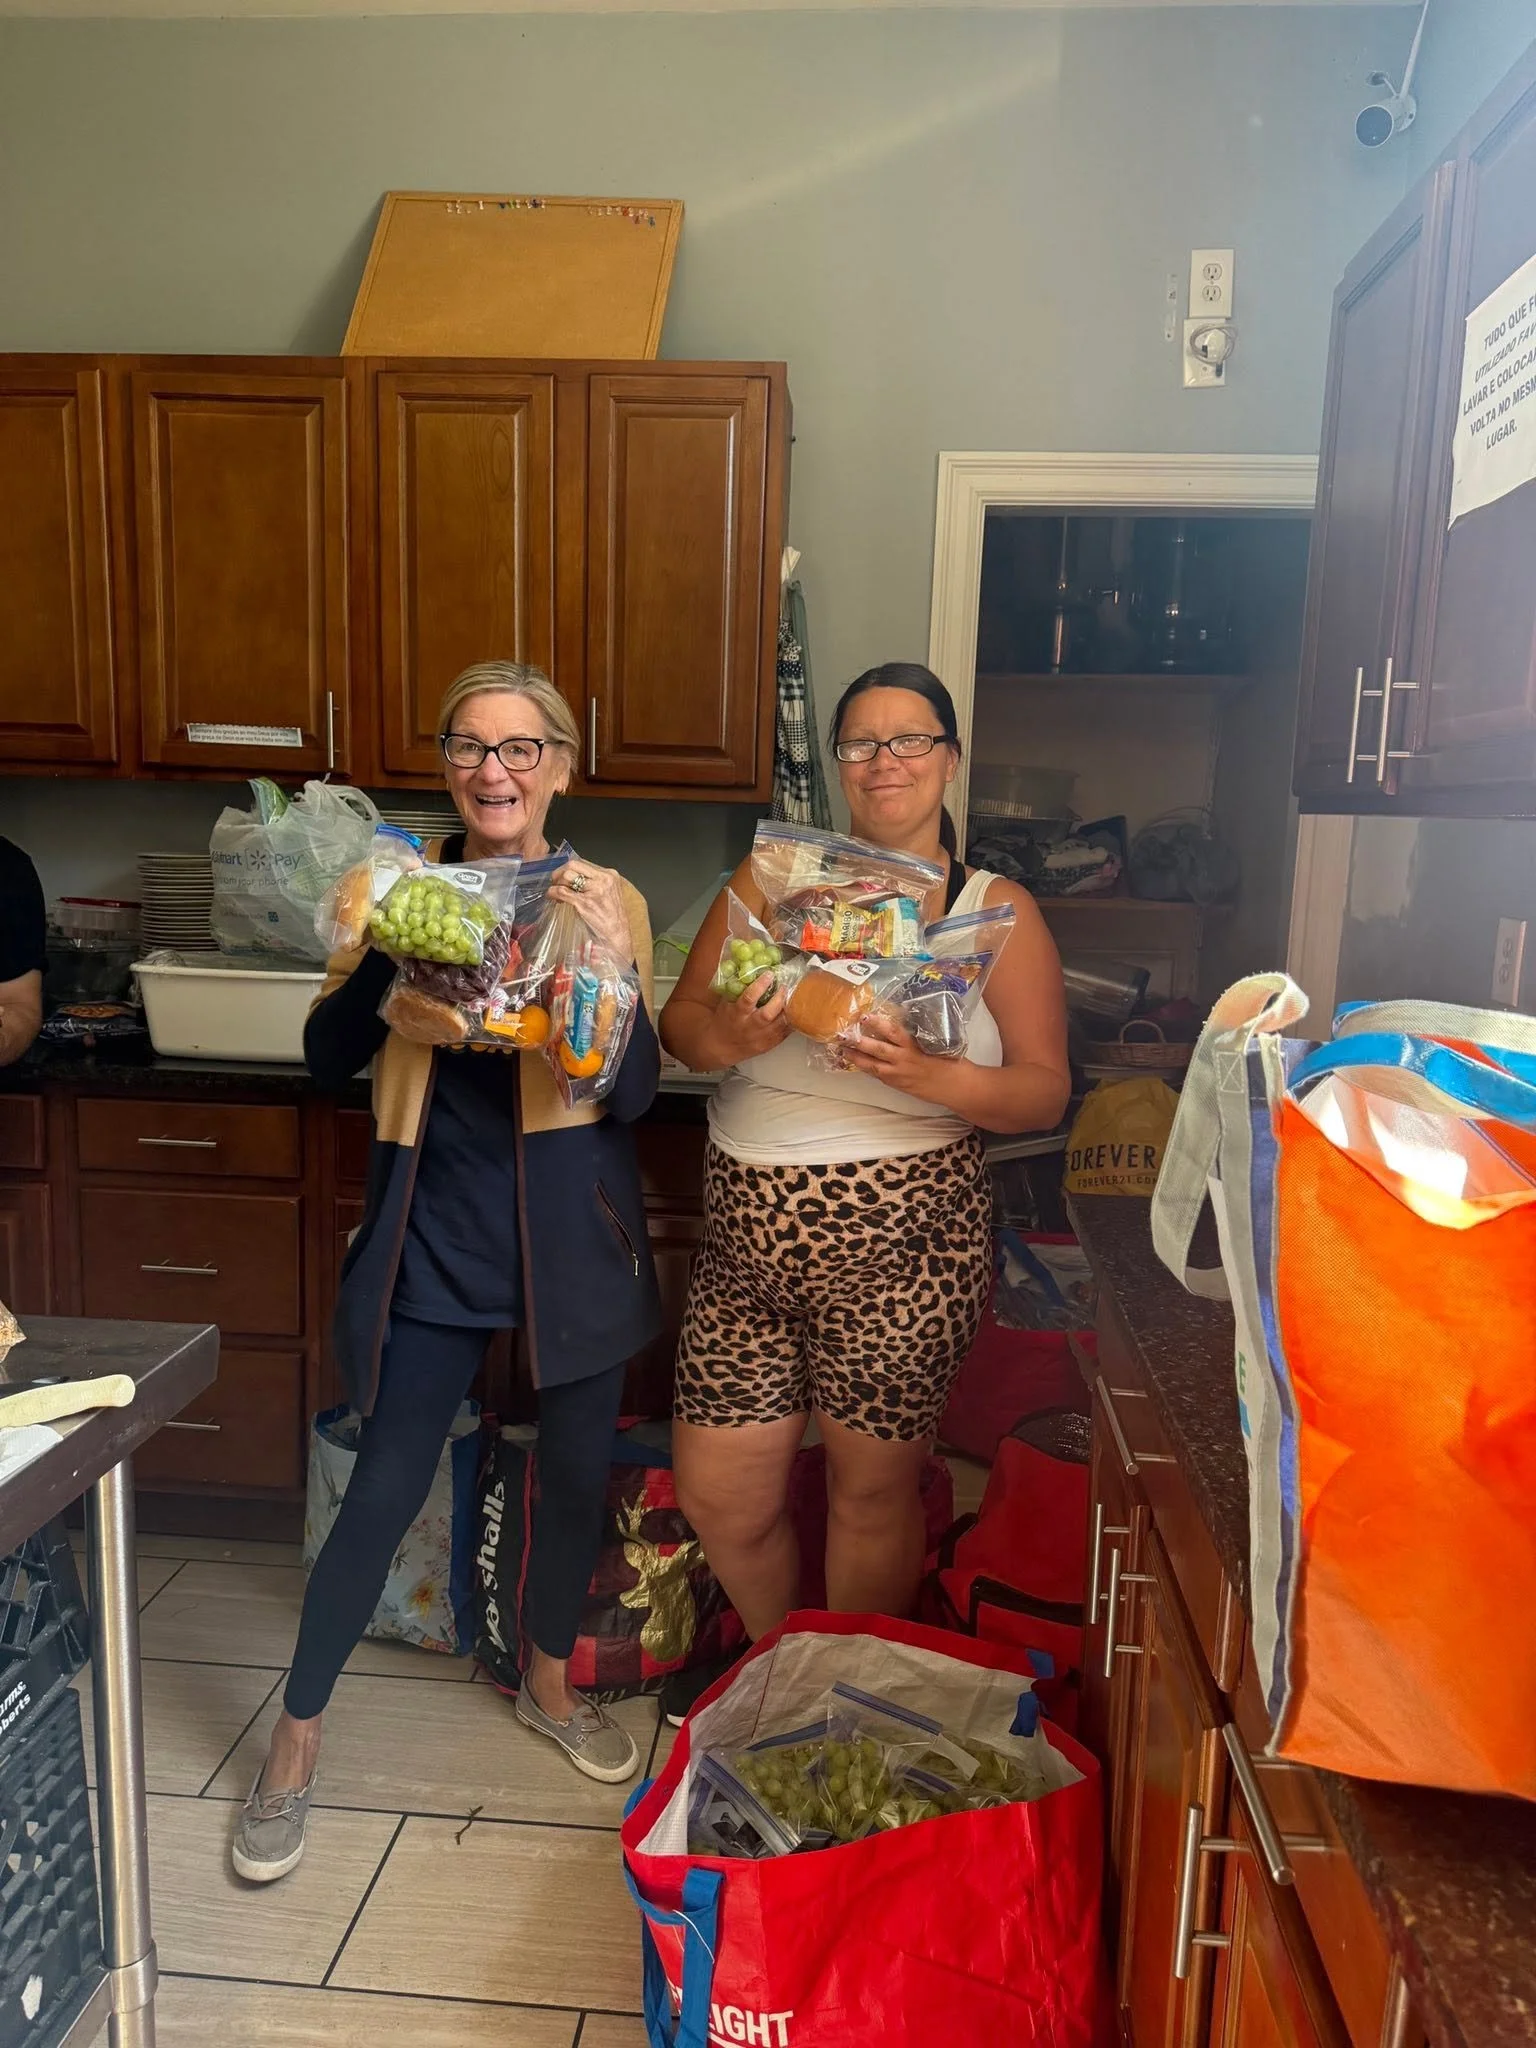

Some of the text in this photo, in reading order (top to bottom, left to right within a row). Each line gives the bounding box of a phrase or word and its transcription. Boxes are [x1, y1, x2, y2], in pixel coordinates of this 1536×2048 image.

[1484, 321, 1507, 351] TUDO
[1508, 301, 1528, 331] QUE
[1475, 337, 1517, 384] UTILIZADO
[1463, 385, 1488, 416] LAVAR
[1490, 378, 1497, 395] E
[1470, 408, 1496, 436] VOLTA
[1498, 396, 1512, 417] NO
[1486, 418, 1518, 451] LUGAR.
[274, 853, 300, 869] Pay
[258, 876, 289, 889] phone
[709, 2003, 794, 2048] IGHT
